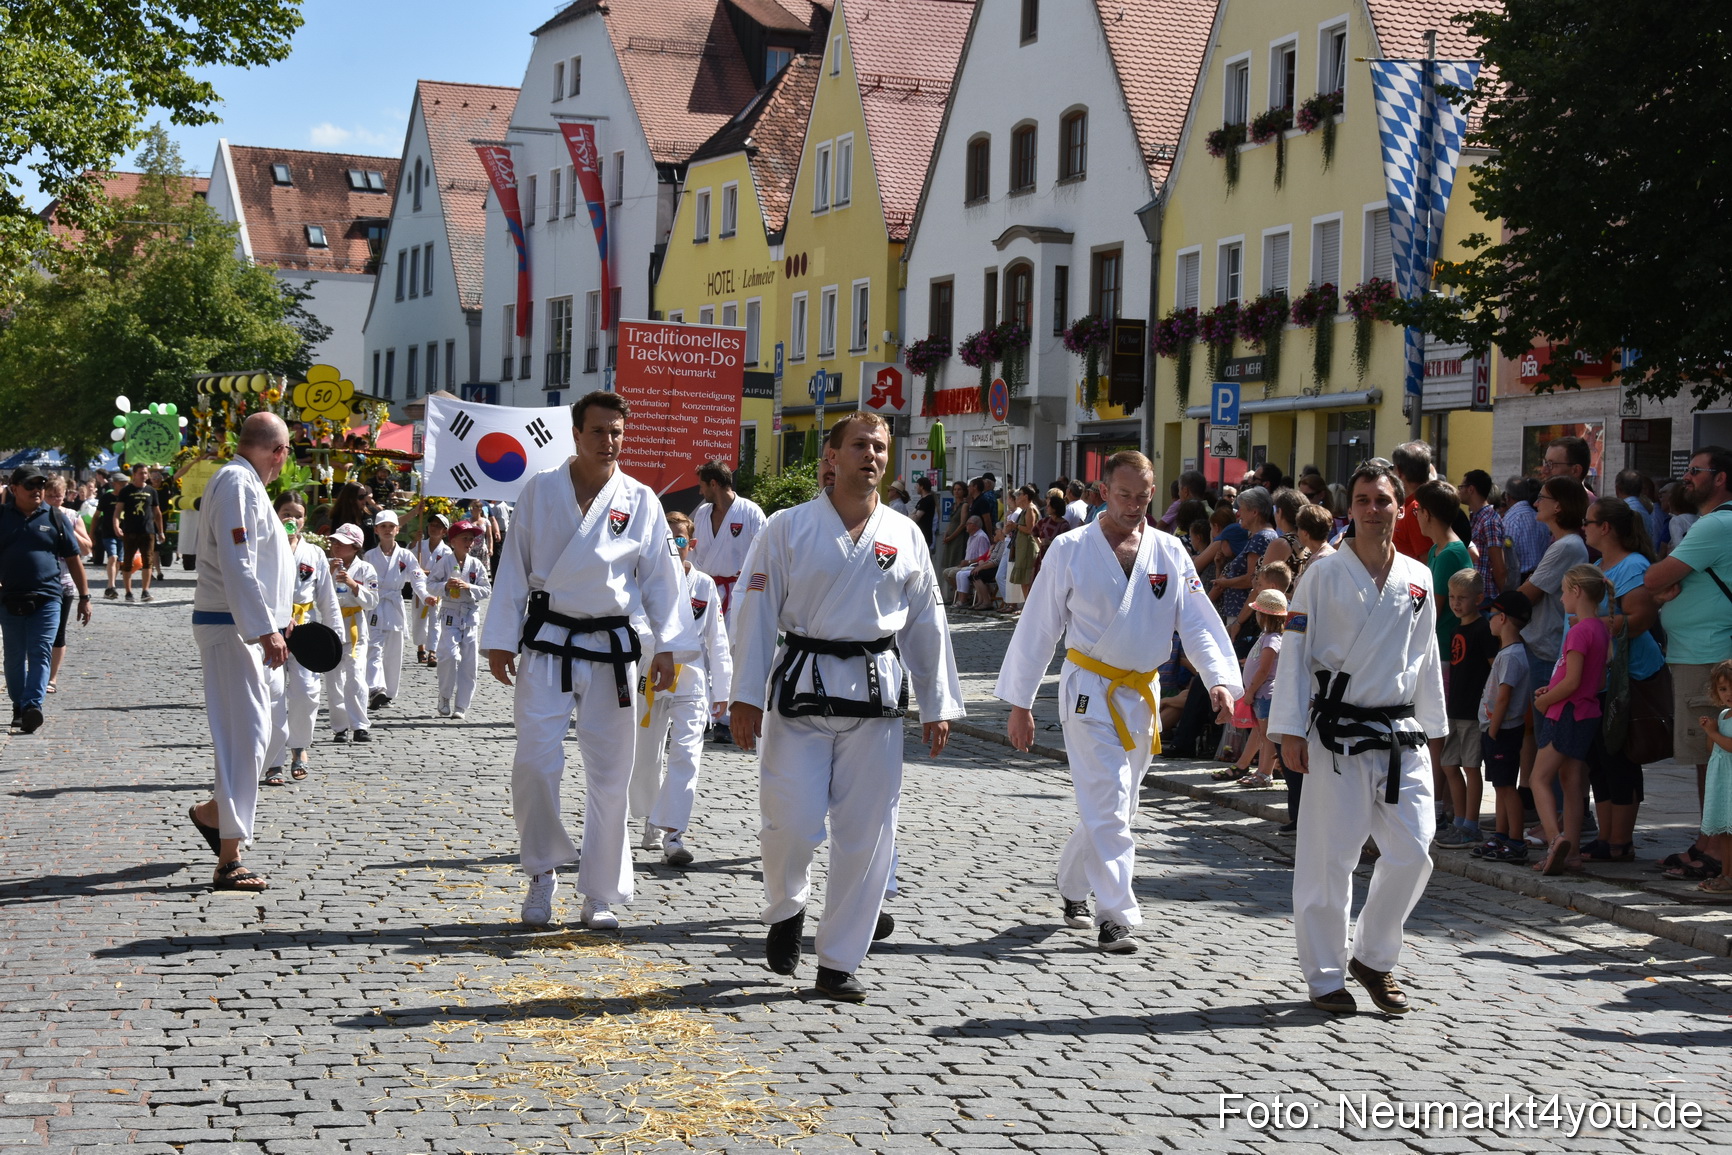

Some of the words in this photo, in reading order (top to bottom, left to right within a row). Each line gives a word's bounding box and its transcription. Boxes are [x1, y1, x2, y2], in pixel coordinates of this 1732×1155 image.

[569, 127, 595, 173] K&L
[707, 268, 735, 296] HOTEL
[742, 265, 775, 288] Lehmeier
[625, 327, 740, 350] Traditionelles
[627, 344, 736, 367] Taekwon-Do
[643, 365, 665, 375] ASV
[667, 366, 716, 379] Neumarkt
[1245, 362, 1261, 375] MEHR
[1444, 359, 1462, 376] KINO
[1521, 358, 1538, 378] DER
[313, 389, 332, 403] 50
[622, 386, 645, 395] Kunst
[646, 386, 660, 395] der
[662, 388, 735, 402] Selbstverteidigung
[626, 398, 670, 408] oordination
[682, 402, 735, 412] Konzentration
[1217, 388, 1234, 421] P
[627, 410, 698, 424] örperbeherrschung
[704, 415, 736, 426] Disziplin
[624, 422, 688, 434] elbstbewusstsein
[703, 427, 733, 438] Respekt
[623, 435, 676, 445] escheidenheit
[692, 439, 732, 449] Höflichkeit
[704, 452, 732, 462] Geduld
